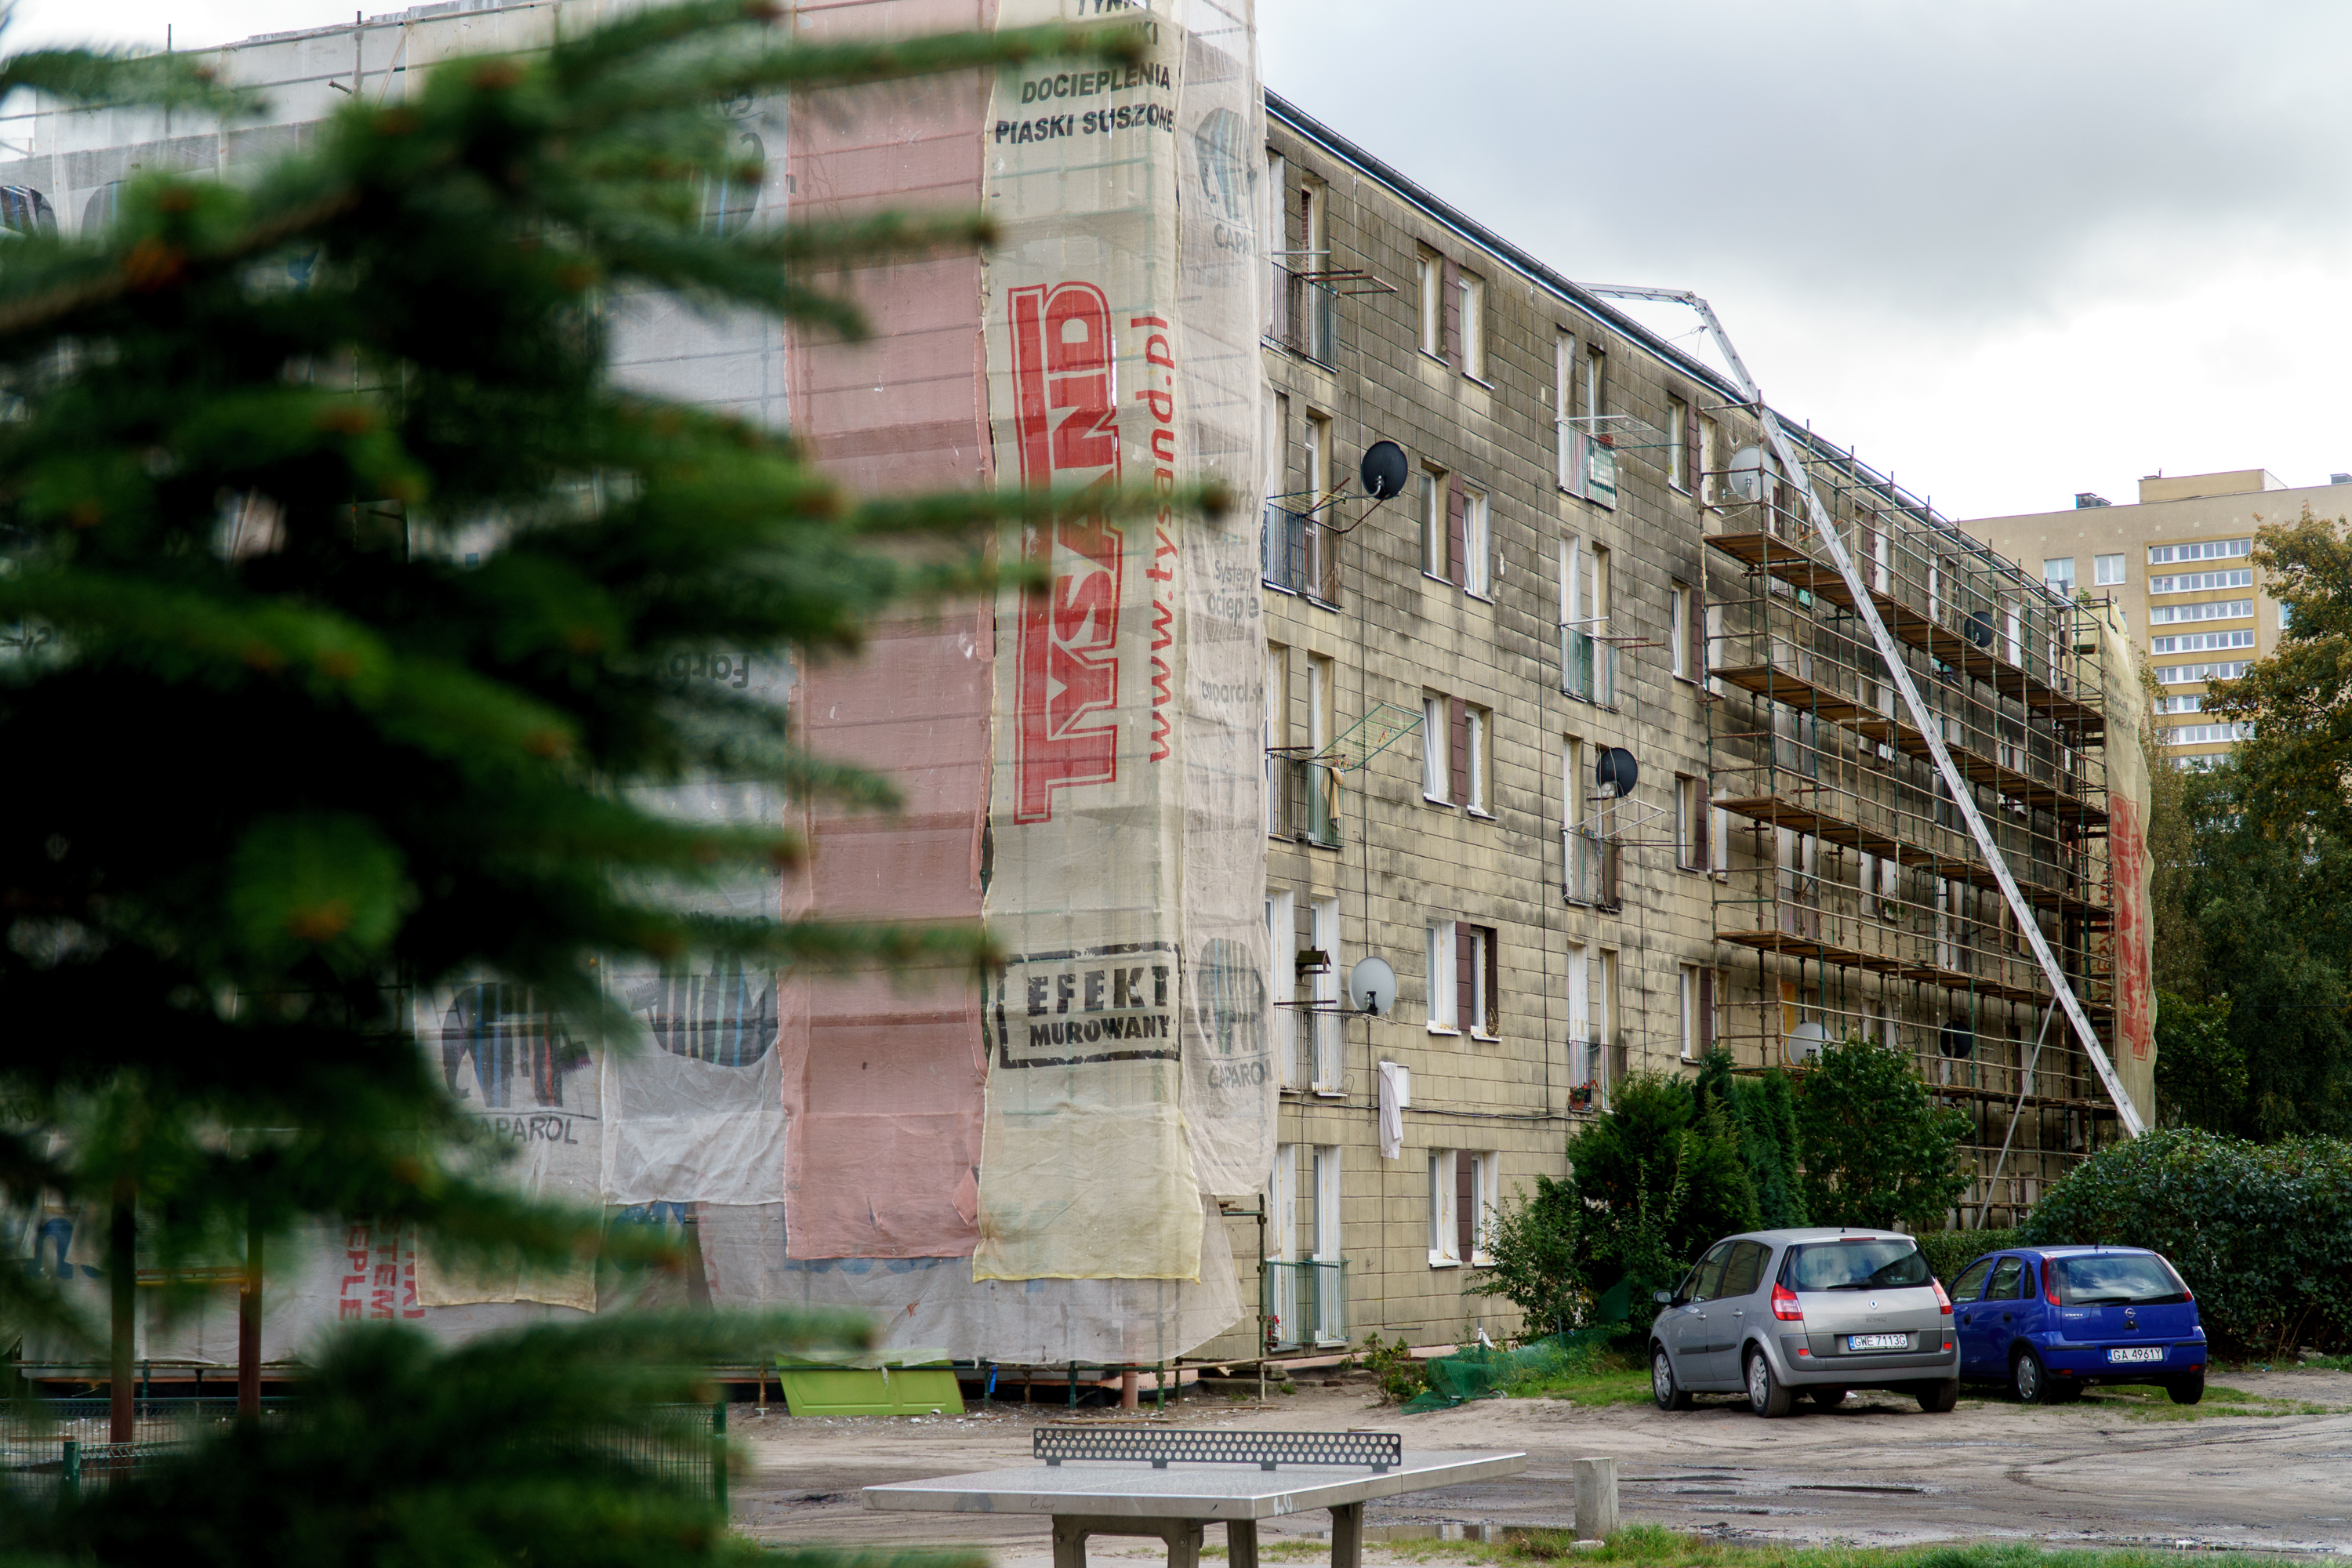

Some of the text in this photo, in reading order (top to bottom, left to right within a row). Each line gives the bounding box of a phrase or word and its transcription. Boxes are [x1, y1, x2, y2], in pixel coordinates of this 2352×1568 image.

[1022, 62, 1171, 104] DOCIEPLENIA
[995, 103, 1174, 144] PIASKI SUSZONE
[1008, 281, 1123, 826] TYSAND
[1131, 316, 1178, 764] www.tysand.pl
[1029, 1014, 1170, 1047] MUROWANY
[475, 1116, 578, 1145] APAROL
[1854, 1334, 1906, 1347] GWE 7113G
[2113, 1348, 2161, 1360] GA 4961Y
